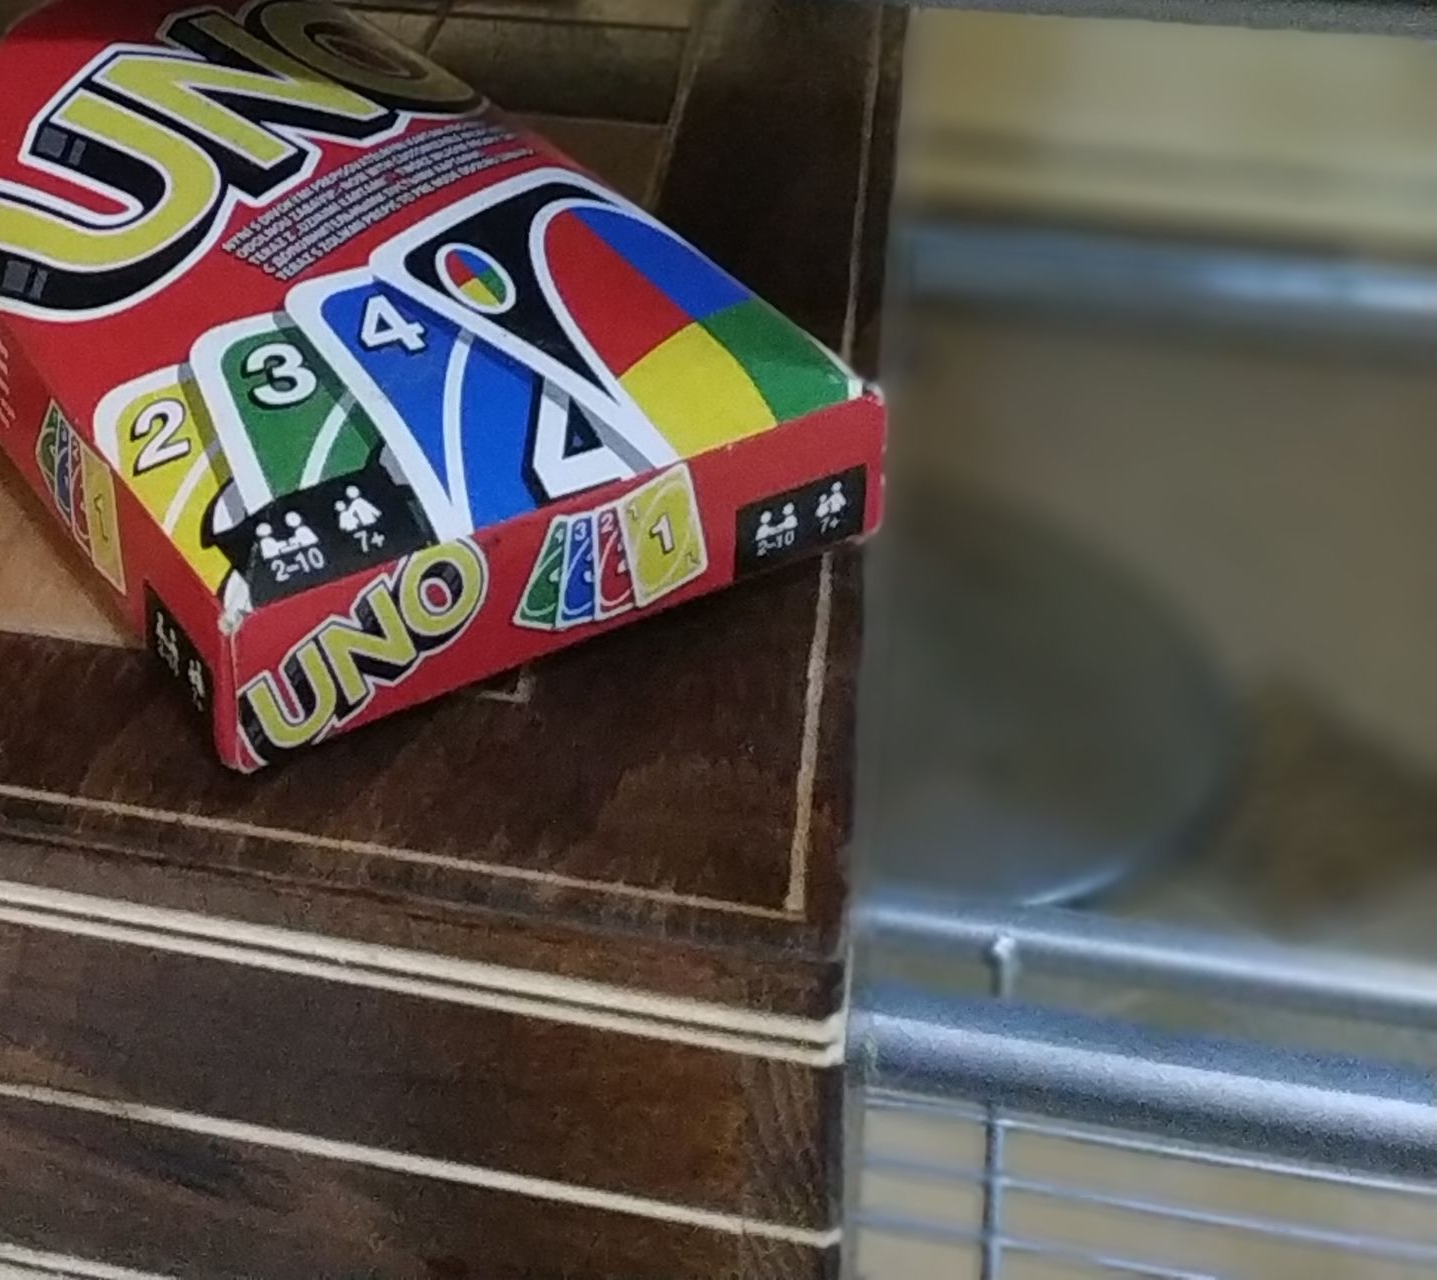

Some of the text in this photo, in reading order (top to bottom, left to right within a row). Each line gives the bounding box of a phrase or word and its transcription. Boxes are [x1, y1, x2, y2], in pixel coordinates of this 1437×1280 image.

[360, 294, 426, 352] 4
[241, 343, 316, 410] 3
[130, 398, 192, 476] 2
[353, 530, 386, 553] 7+
[649, 512, 675, 555] 1
[271, 547, 325, 582] 2-10
[238, 538, 487, 752] UNO
